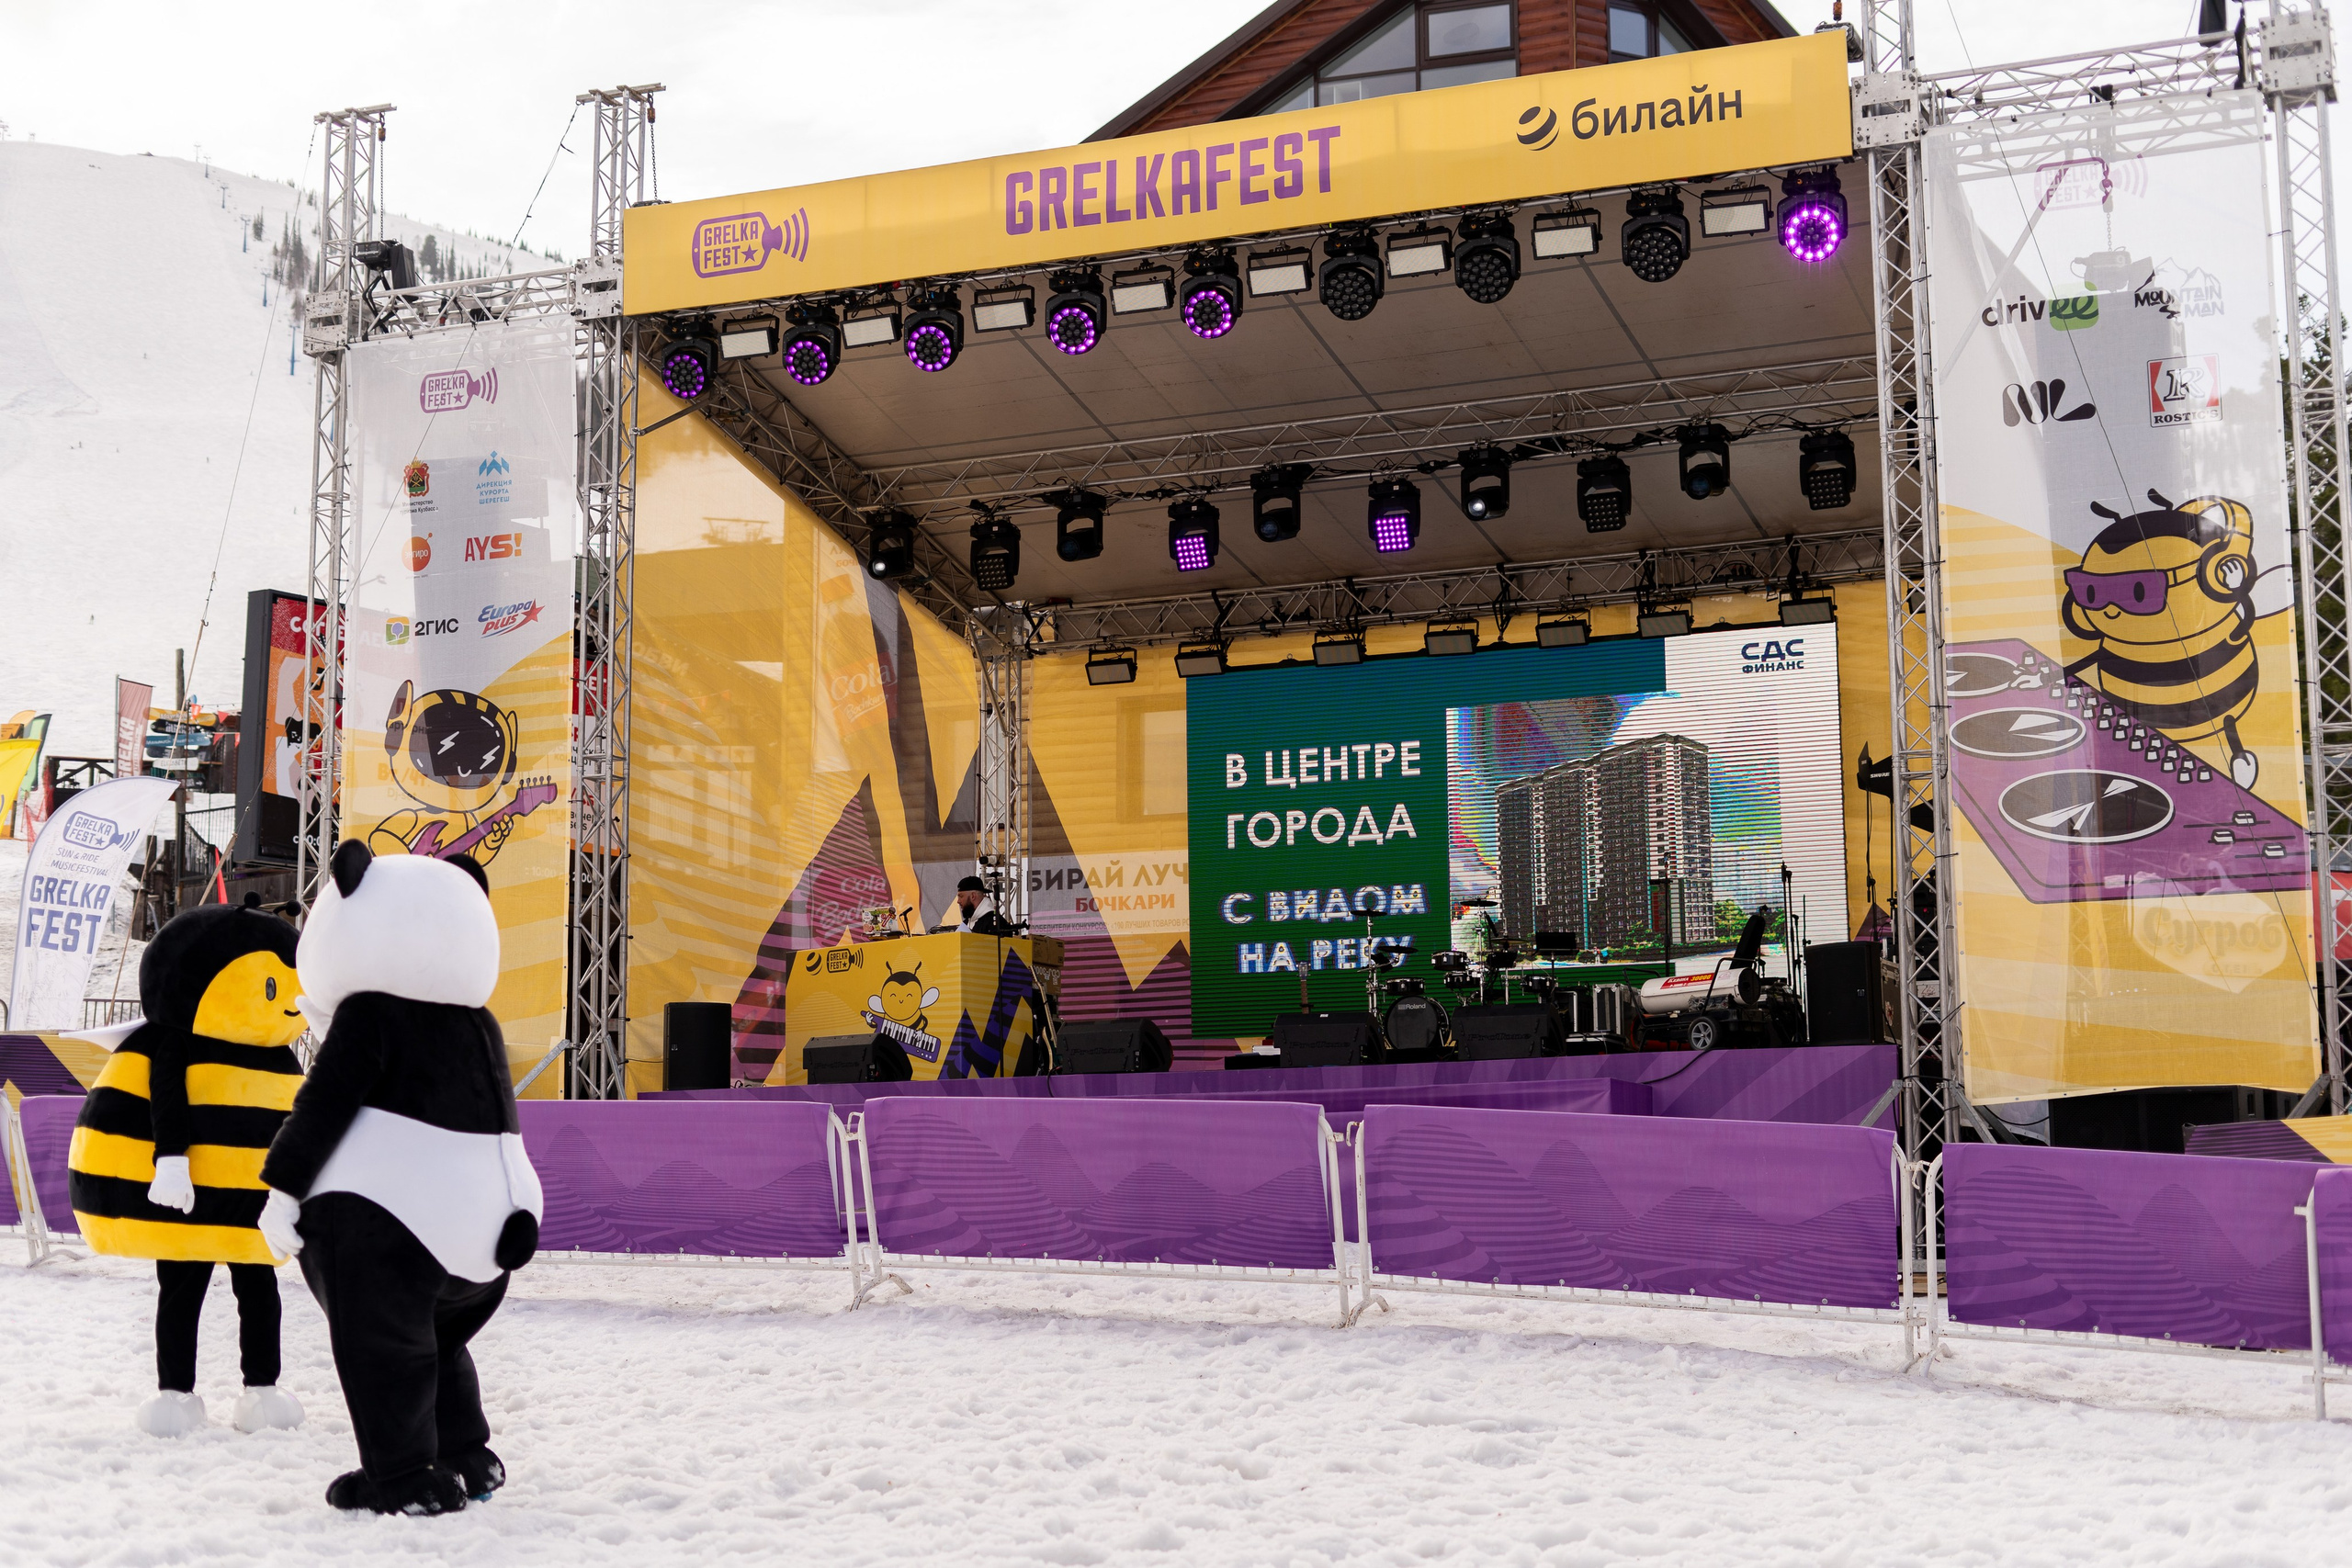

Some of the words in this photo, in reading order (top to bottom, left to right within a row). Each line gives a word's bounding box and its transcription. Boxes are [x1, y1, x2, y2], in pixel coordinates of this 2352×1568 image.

[1572, 84, 1743, 140] билайн
[1005, 125, 1341, 236] GRELKAFEST
[2044, 164, 2098, 186] GRELKA
[2046, 185, 2082, 204] FEST
[704, 220, 759, 247] GRELKA
[704, 244, 741, 269] FEST
[2134, 286, 2222, 308] MOUNTAIN
[2185, 300, 2225, 318] MAN
[427, 376, 466, 392] GRELKA
[427, 391, 453, 408] FEST
[2154, 410, 2219, 424] ROSTIC'S
[476, 479, 513, 490] ДИРЕКЦИЯ
[480, 489, 509, 497] КУРОРТА
[479, 496, 510, 504] ШЕРЕГЕШ
[464, 533, 523, 562] AYS!
[414, 617, 459, 637] 2ГИС
[1741, 638, 1804, 663] СДС
[1741, 659, 1805, 674] ФИНАНС
[831, 662, 891, 701] Cola
[1226, 752, 1248, 788] В
[1265, 739, 1421, 790] ЦЕНТРЕ
[74, 816, 112, 835] GRELKA
[1227, 803, 1418, 850] ГОРОДА
[70, 829, 94, 844] FEST
[56, 847, 74, 858] SUN
[74, 851, 80, 860] &
[80, 852, 100, 863] RIDE
[29, 875, 111, 910] GRELKA
[841, 874, 886, 893] Cola
[1075, 893, 1175, 913] БОЧКАРИ
[1221, 892, 1256, 925] С
[1266, 884, 1429, 924] ВИДОМ
[24, 907, 102, 954] FEST
[1125, 919, 1150, 930] ЛУЧШИХ
[1151, 919, 1180, 928] ТОВАРОВ
[830, 952, 847, 962] GRELKA
[830, 961, 842, 970] FEST
[1238, 940, 1297, 974] НА
[1690, 974, 1712, 982] 30000
[1406, 1002, 1427, 1010] Roland
